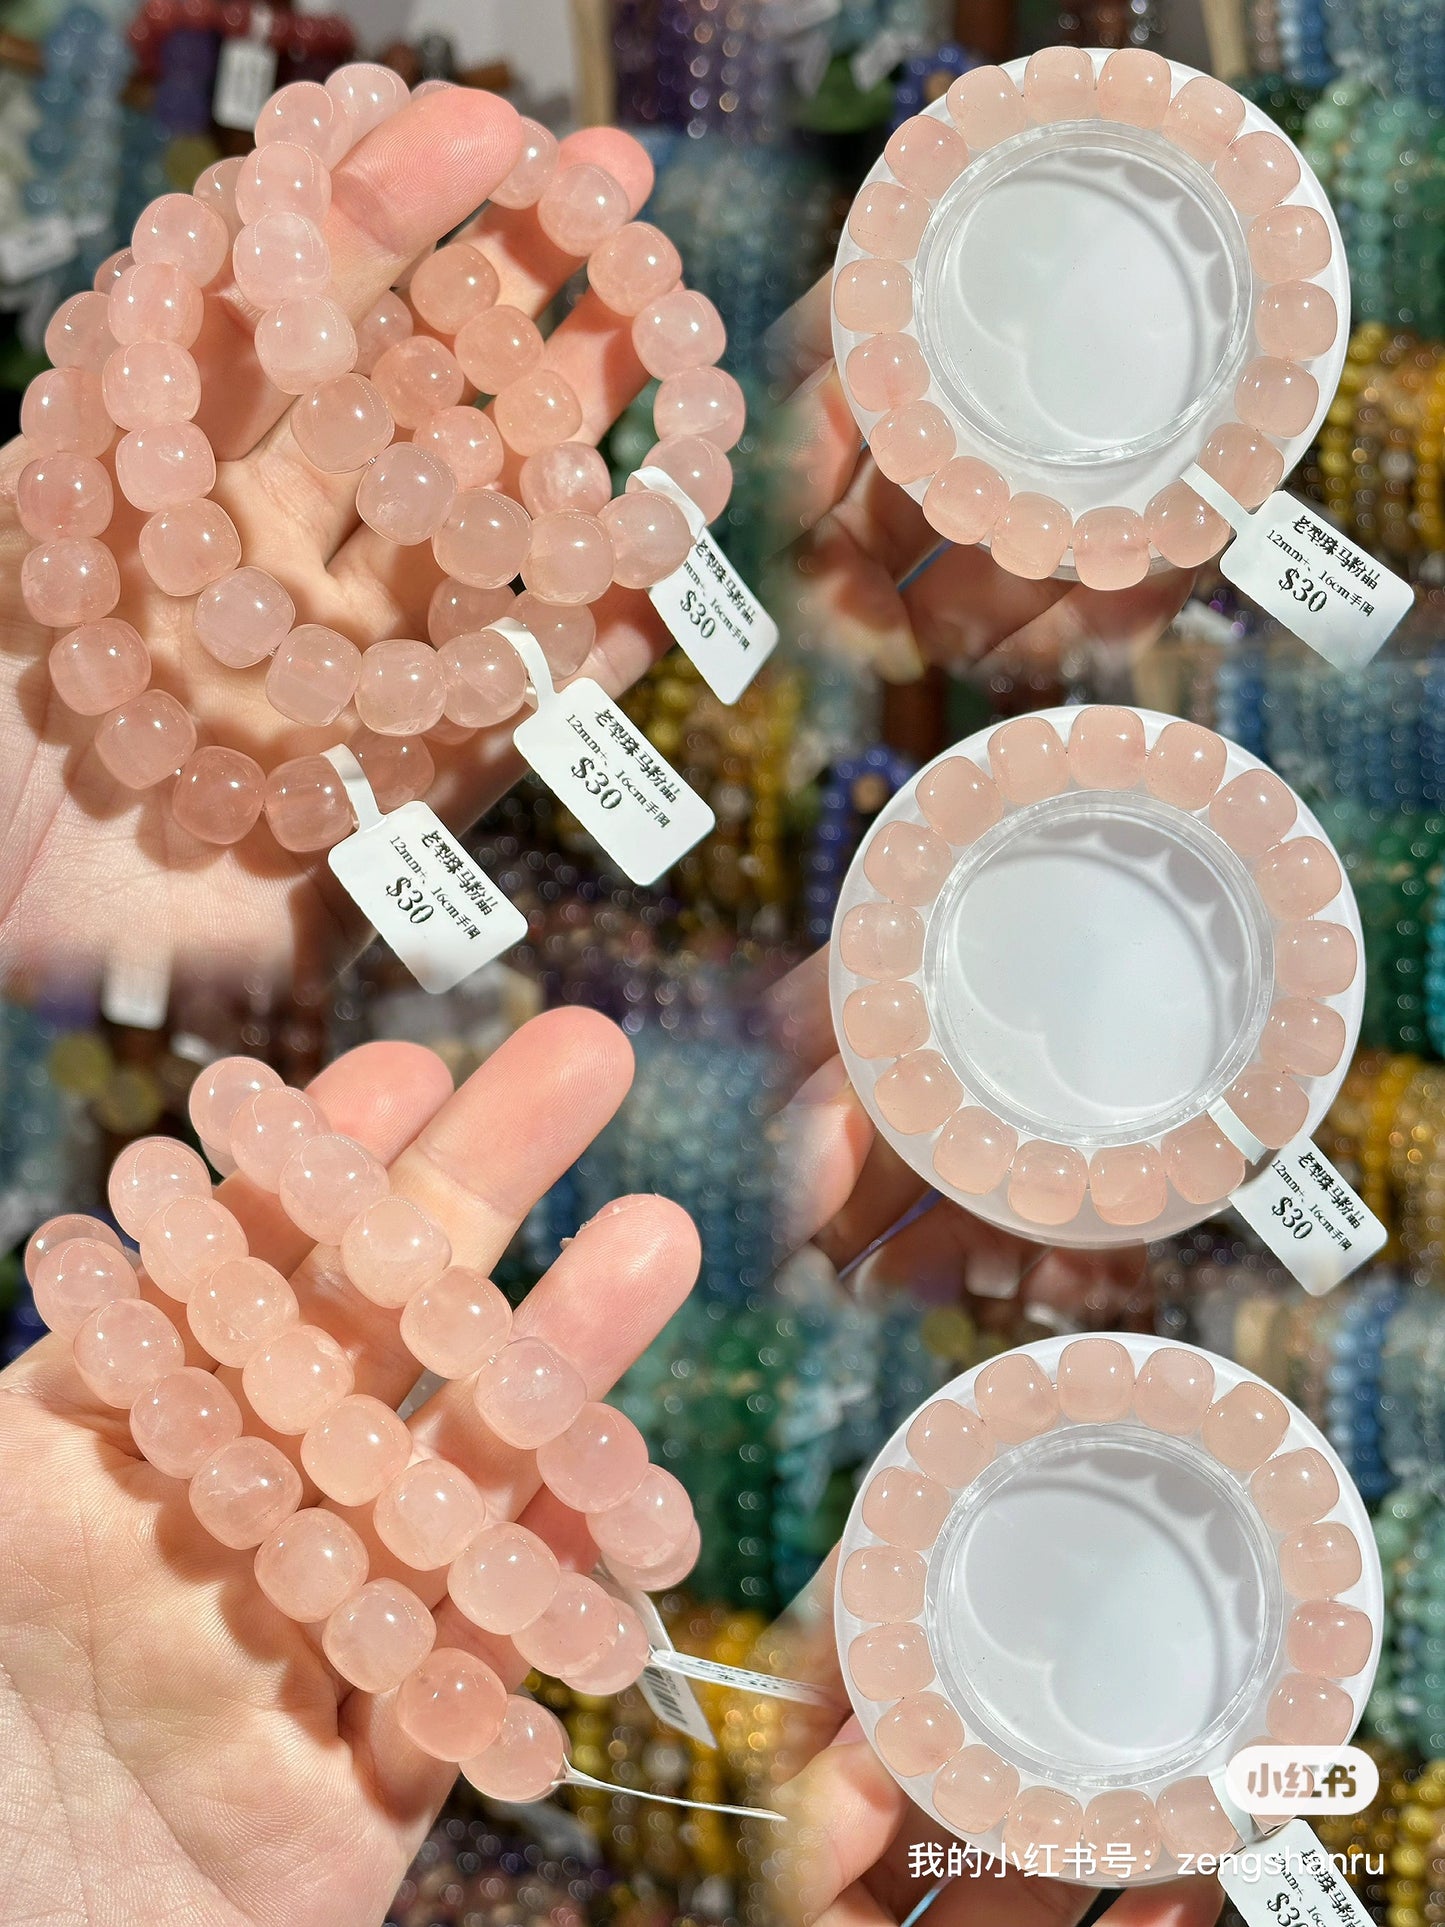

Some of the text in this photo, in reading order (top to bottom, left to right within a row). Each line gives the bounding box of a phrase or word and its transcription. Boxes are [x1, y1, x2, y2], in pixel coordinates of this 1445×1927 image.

[680, 590, 716, 639] $30
[1278, 567, 1329, 613] $30
[570, 756, 623, 810] $30
[385, 875, 434, 924] $30
[1271, 1196, 1314, 1240] $30
